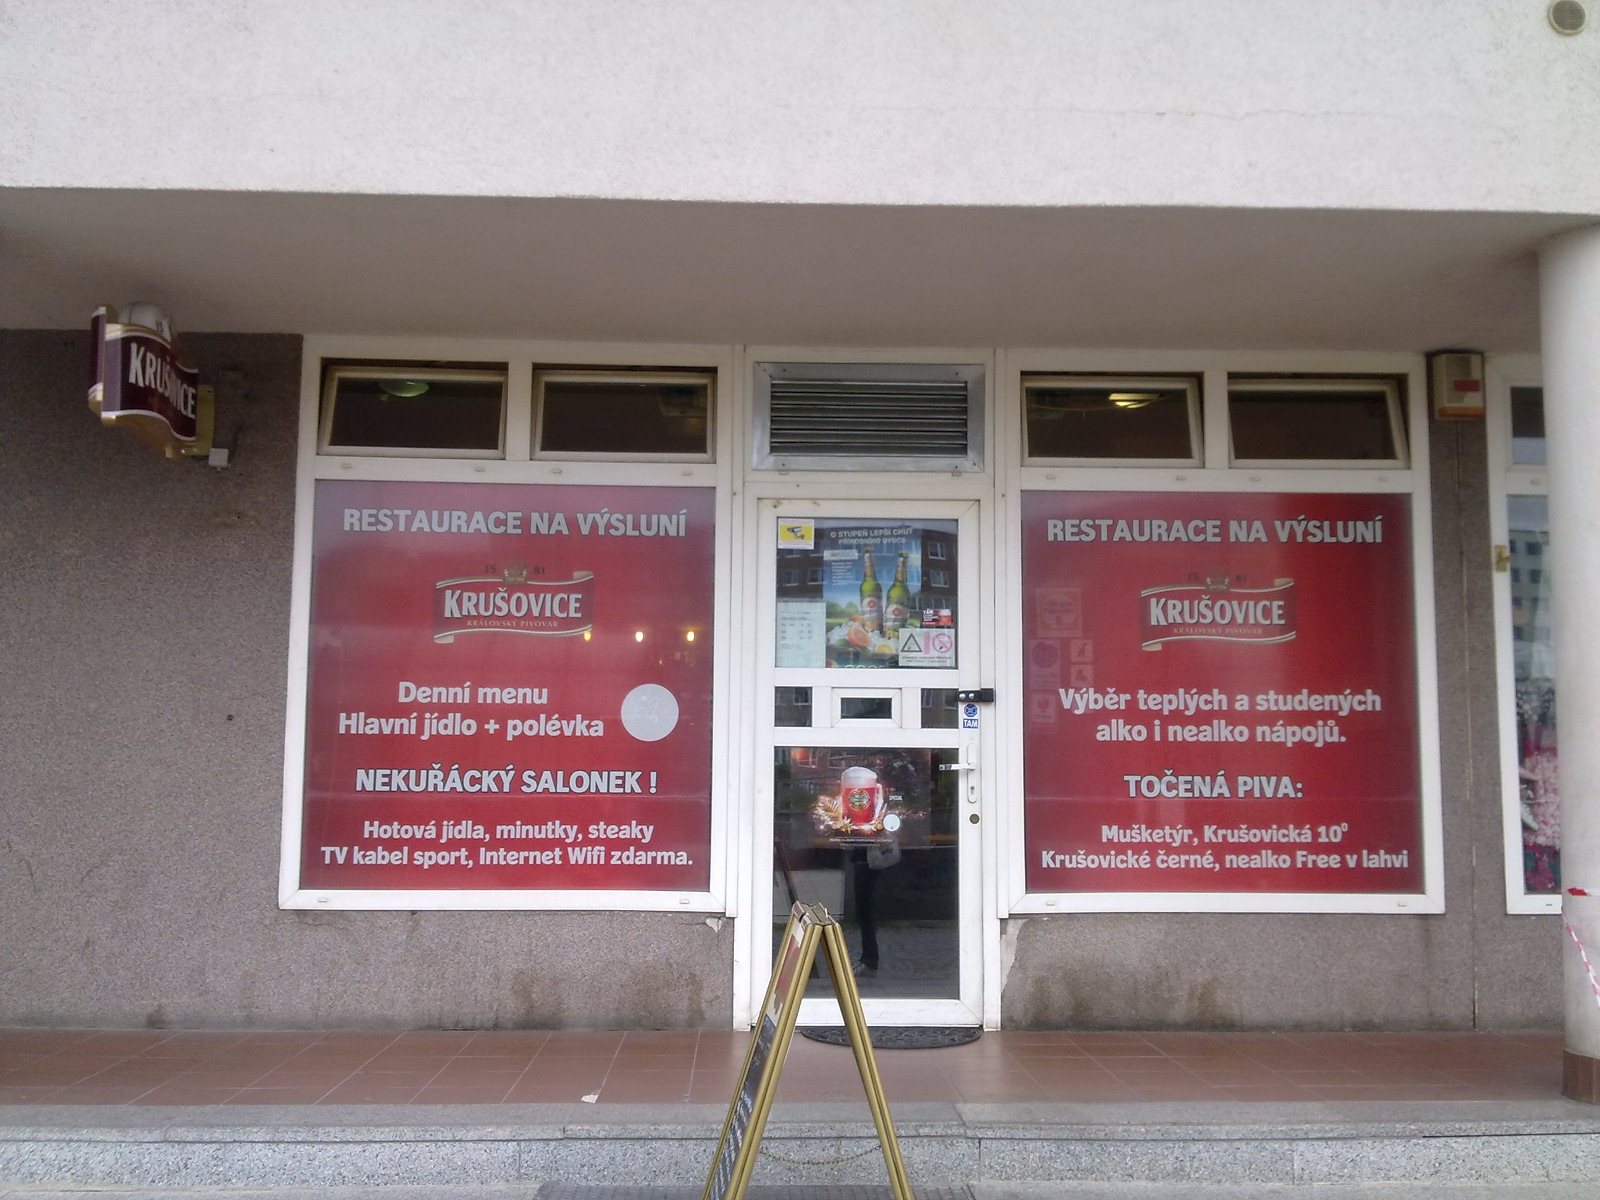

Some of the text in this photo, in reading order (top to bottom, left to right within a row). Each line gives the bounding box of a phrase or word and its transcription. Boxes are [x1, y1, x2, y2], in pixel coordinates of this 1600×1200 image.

[344, 508, 688, 536] RESTAURACE NA VÝSLUNÍ
[1048, 515, 1383, 543] RESTAURACE NA VÝSLUNÍ
[444, 587, 583, 617] KRUŠOVICE
[1150, 596, 1286, 626] KRUŠOVICE
[399, 682, 547, 704] Denní menu
[1059, 688, 1381, 716] Výběr teplých a studených
[339, 712, 603, 740] Hlavní jídlo + polévka
[1096, 719, 1346, 747] alko i nealko nápojů.
[356, 764, 656, 794] NEKUŘÁCKÝ SALONEK !
[1124, 770, 1302, 798] TOČENÁ PIVA:
[364, 820, 654, 843] Hotová jídla, minutky, steaky
[1102, 824, 1198, 847] Mušketýr,
[1204, 825, 1312, 842] Krušovická
[321, 846, 693, 869] TV kabel sport, Internet Wifi zdarma.
[1042, 850, 1408, 871] Krušovické černé, nealko Free v lahvi
